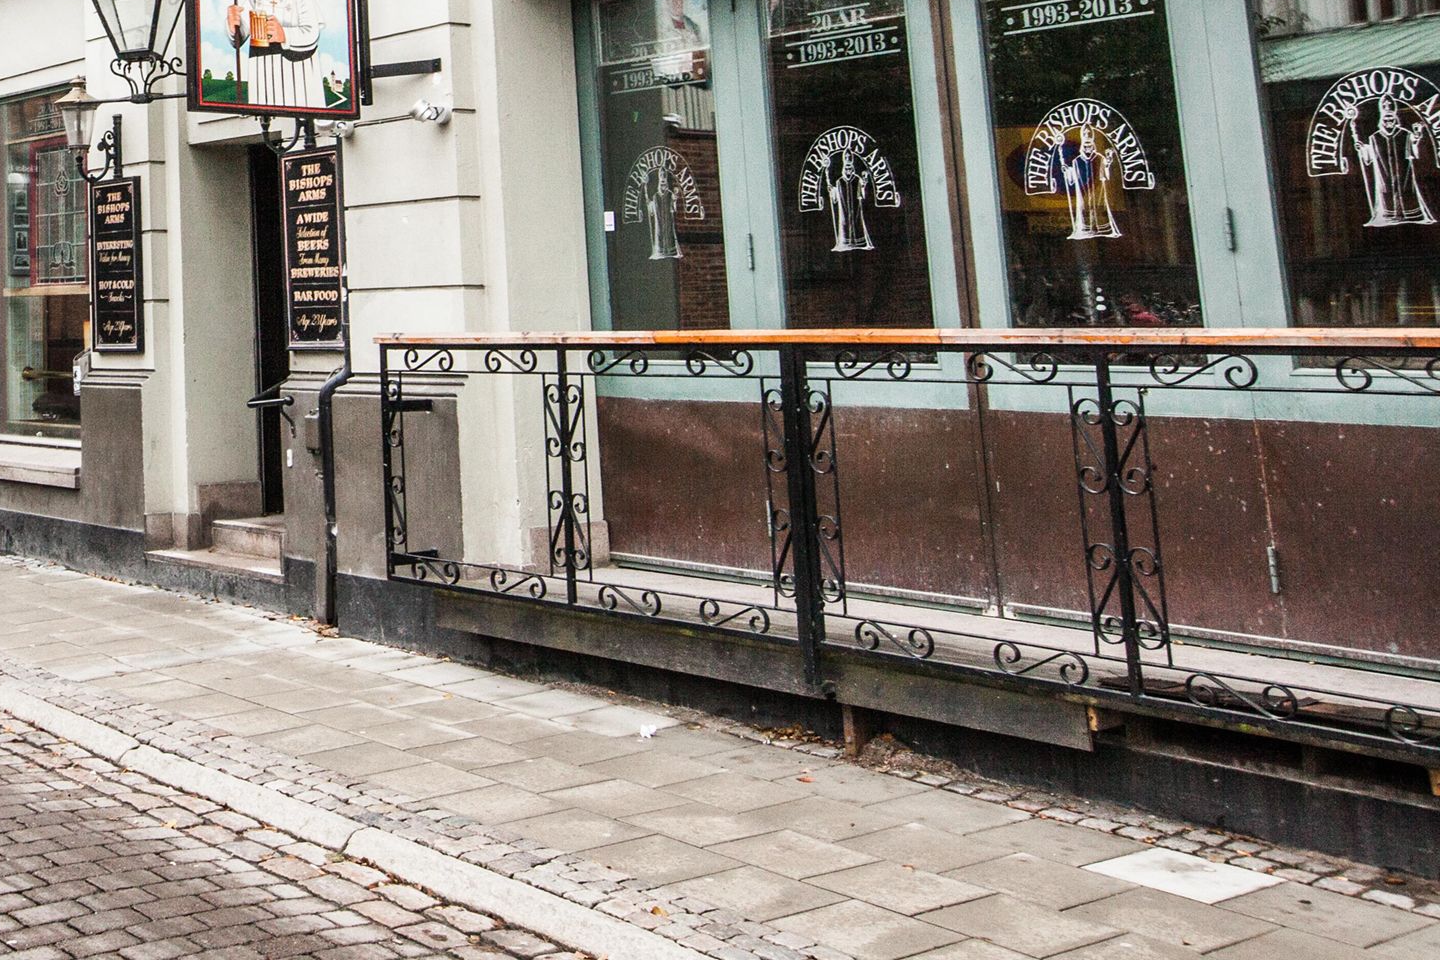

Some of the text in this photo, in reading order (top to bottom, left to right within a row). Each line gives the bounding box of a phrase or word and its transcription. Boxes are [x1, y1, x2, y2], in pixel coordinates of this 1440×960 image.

[811, 13, 832, 33] 20
[799, 32, 886, 63] 1993-2013
[1311, 70, 1419, 169] THE BISHOPS
[1028, 102, 1146, 189] THE BISHOPS ARMS
[301, 162, 321, 177] THE
[801, 129, 894, 207] THE BISHOPS ARMS
[289, 175, 333, 191] BISHOPS
[624, 148, 699, 219] THE BISHOPS ARMS
[107, 192, 122, 202] THE
[298, 188, 327, 202] ARMS
[97, 203, 130, 215] BISHOPS
[104, 213, 125, 225] ARMS
[296, 211, 329, 225] A WIDE
[297, 239, 329, 251] BEERS
[291, 266, 339, 279] BREWERIES
[117, 280, 134, 289] COLD
[294, 290, 338, 302] BAR FOOD
